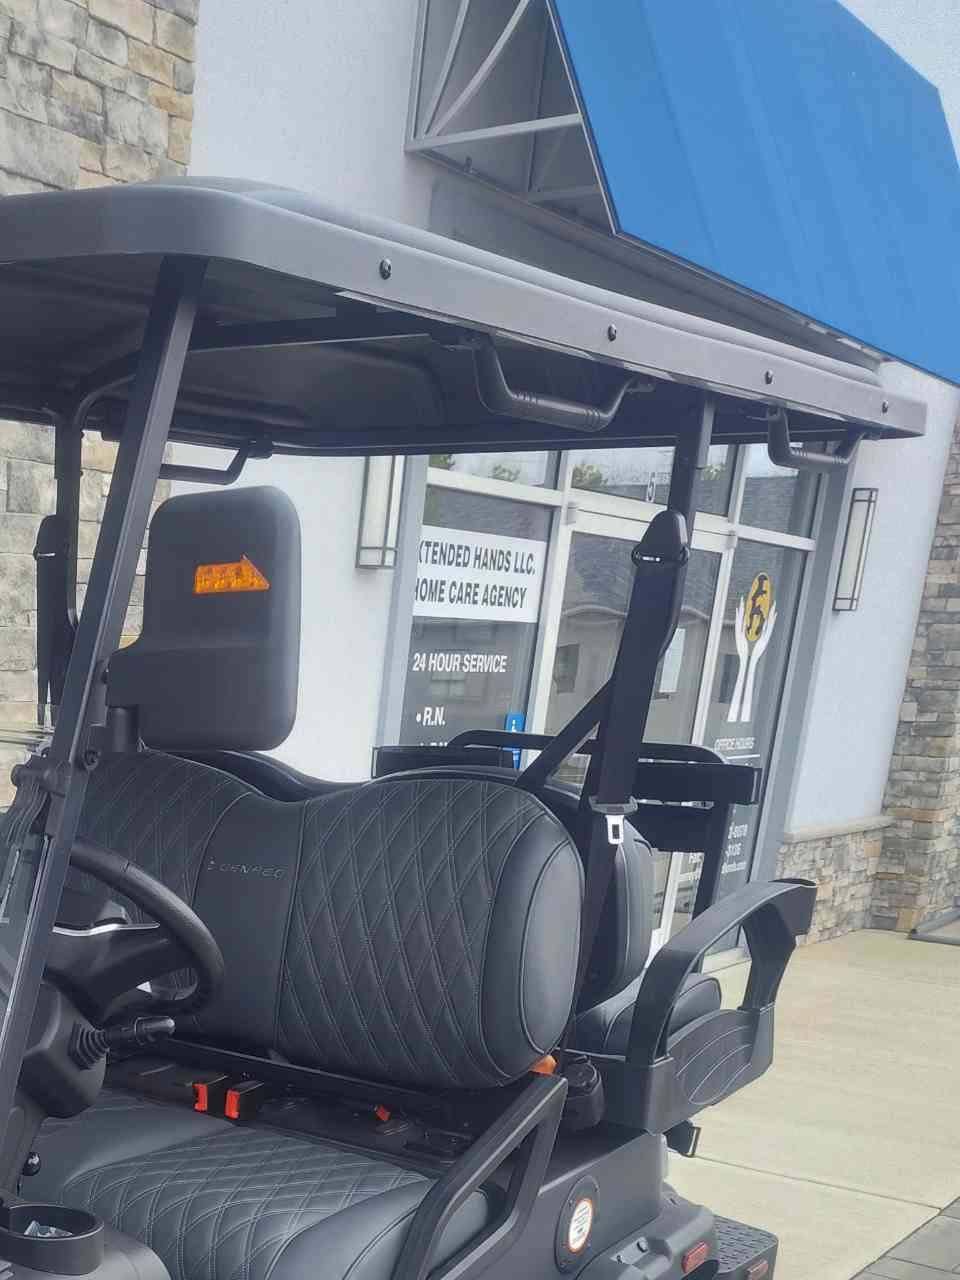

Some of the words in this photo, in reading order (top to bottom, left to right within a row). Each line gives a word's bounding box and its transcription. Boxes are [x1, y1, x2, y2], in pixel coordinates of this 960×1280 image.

[473, 545, 512, 573] HANDS
[448, 581, 480, 605] CARE
[481, 583, 528, 608] AGENCY
[412, 652, 427, 672] 24
[428, 653, 462, 672] HOUR
[462, 654, 508, 673] SERVICE
